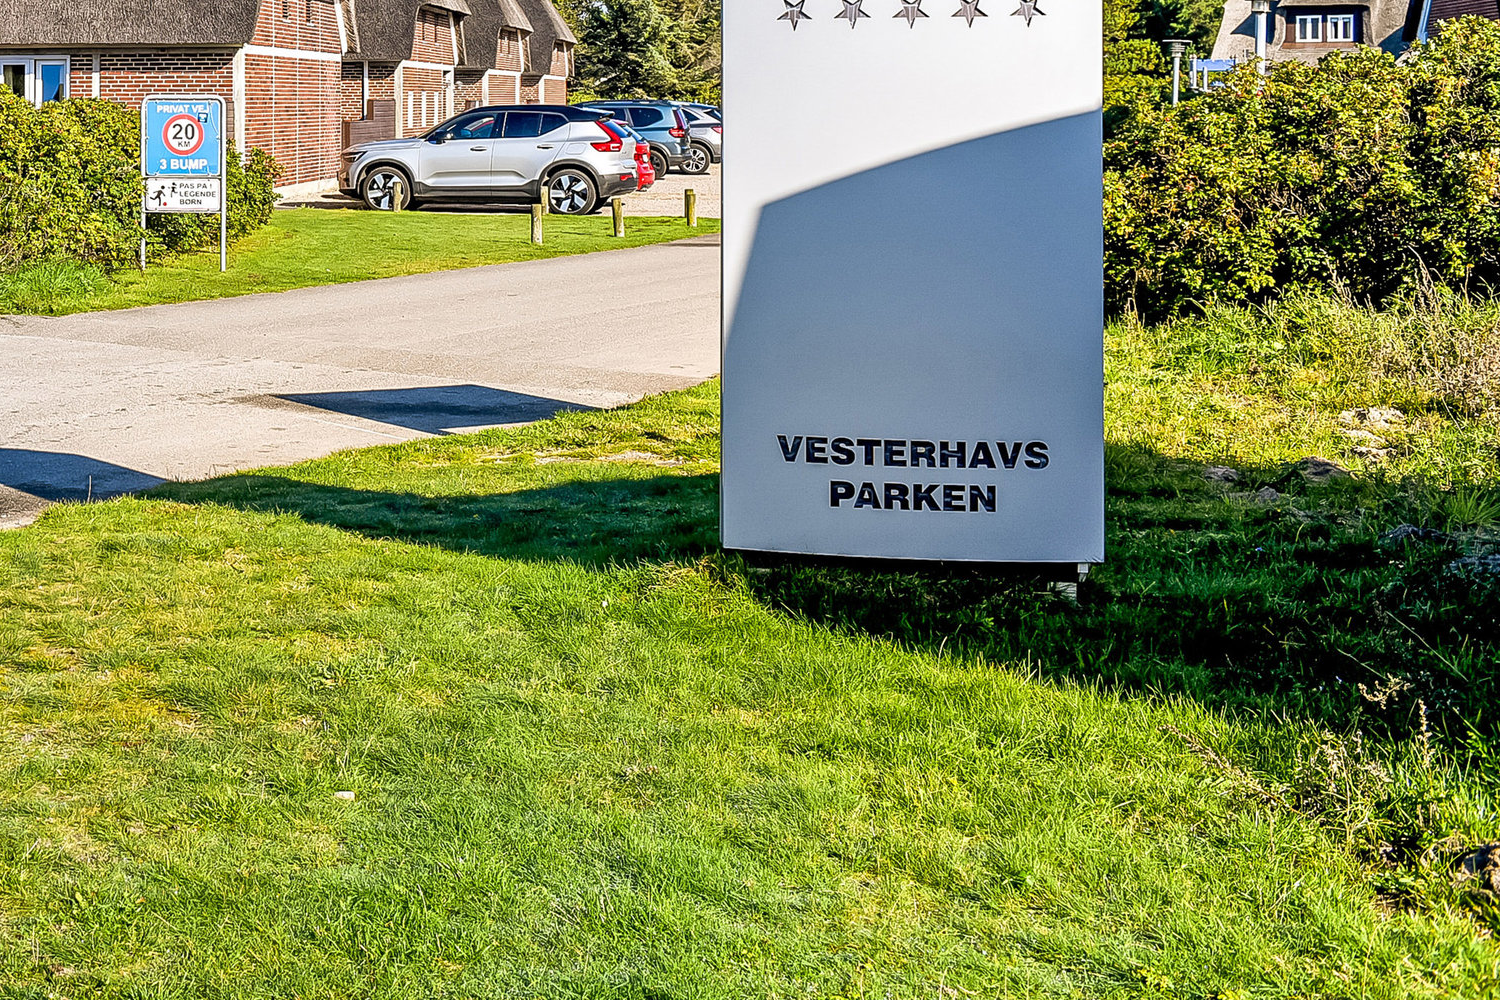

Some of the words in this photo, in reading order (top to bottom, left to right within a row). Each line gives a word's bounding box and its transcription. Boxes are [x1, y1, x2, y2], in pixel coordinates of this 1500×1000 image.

[156, 104, 190, 113] PRIVAT
[191, 104, 209, 113] VEJ
[172, 123, 195, 140] 20
[159, 158, 167, 170] 3
[170, 158, 208, 170] BUMP
[179, 190, 216, 198] LEGENDE
[776, 434, 1051, 470] VESTERHAVS
[829, 480, 997, 513] PARKEN
